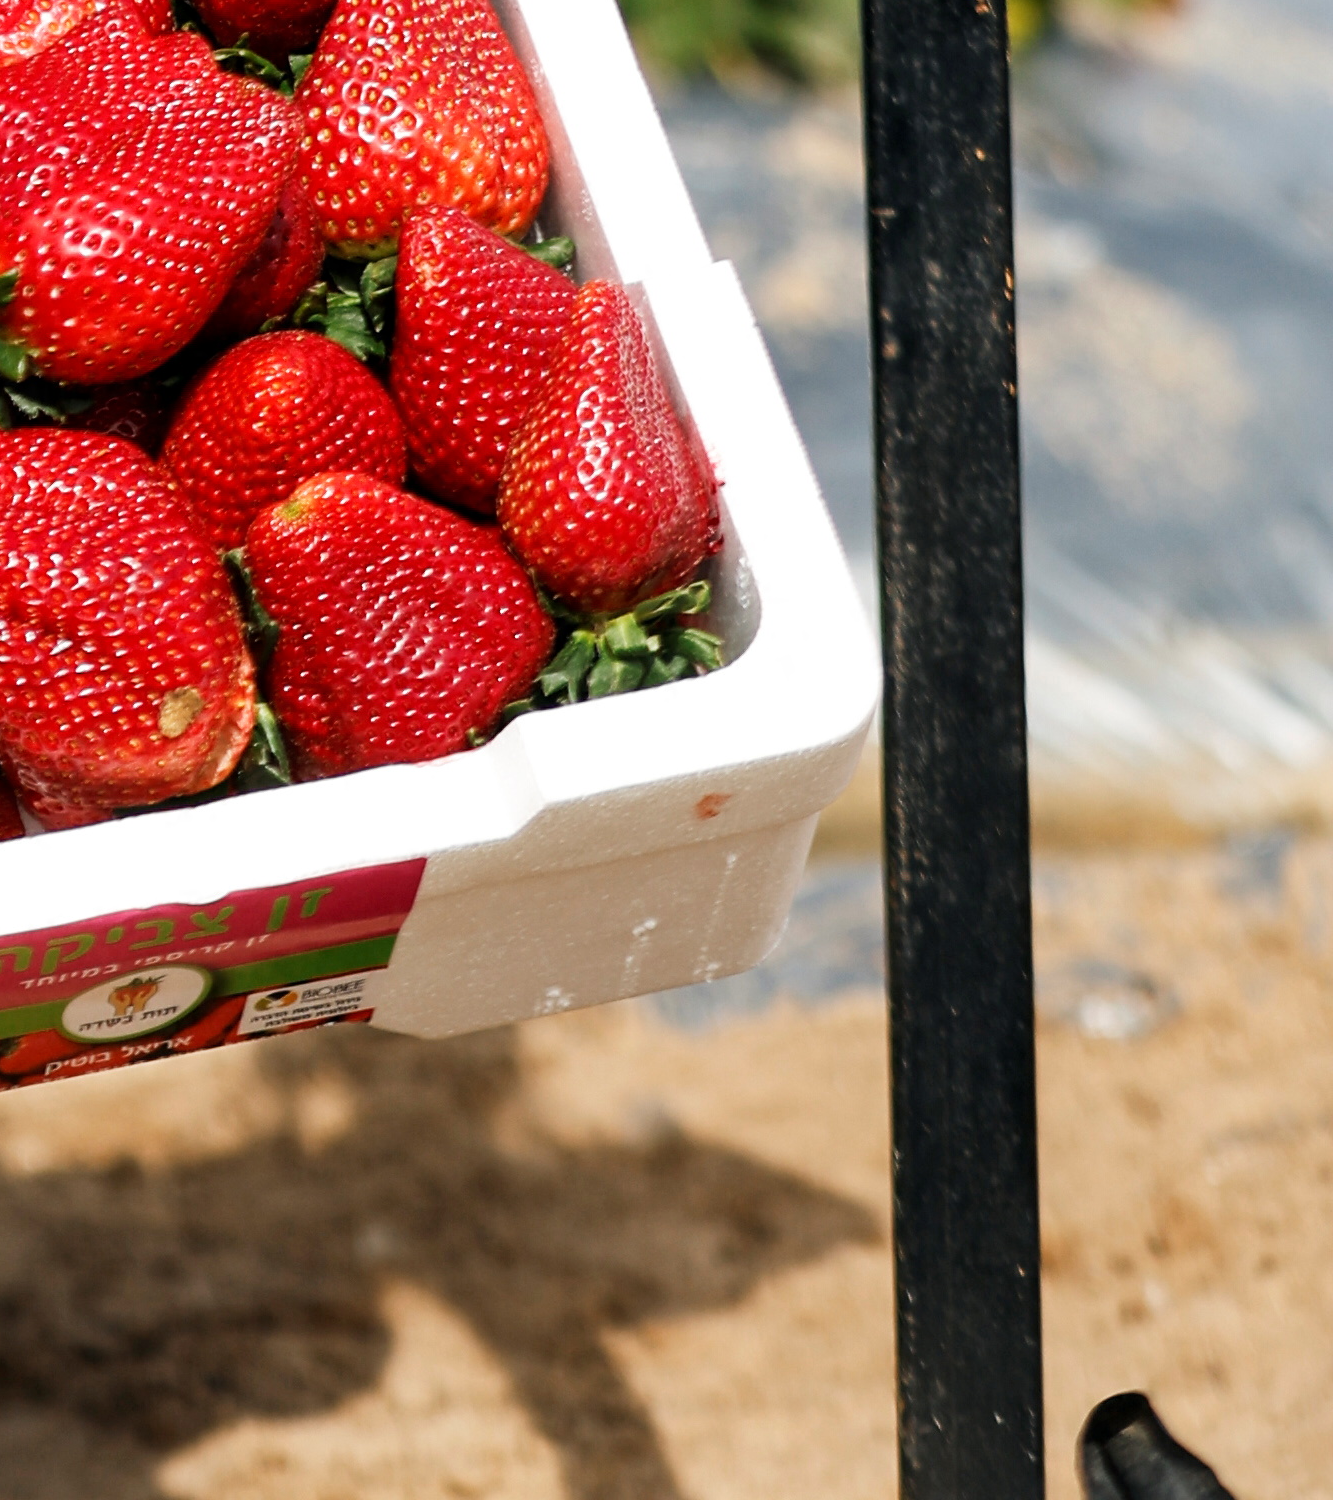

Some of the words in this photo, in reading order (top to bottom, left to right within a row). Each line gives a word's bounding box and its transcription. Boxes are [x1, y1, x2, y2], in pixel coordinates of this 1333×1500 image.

[265, 886, 334, 933] זן
[133, 940, 235, 967] קריספי
[246, 933, 272, 949] זן
[19, 963, 119, 991] במיוחד
[299, 978, 367, 1000] BIOBEE
[78, 1014, 135, 1032] בשדה
[140, 1005, 179, 1020] תות
[119, 1034, 195, 1059] אריאל
[44, 1051, 112, 1077] בוטיק
